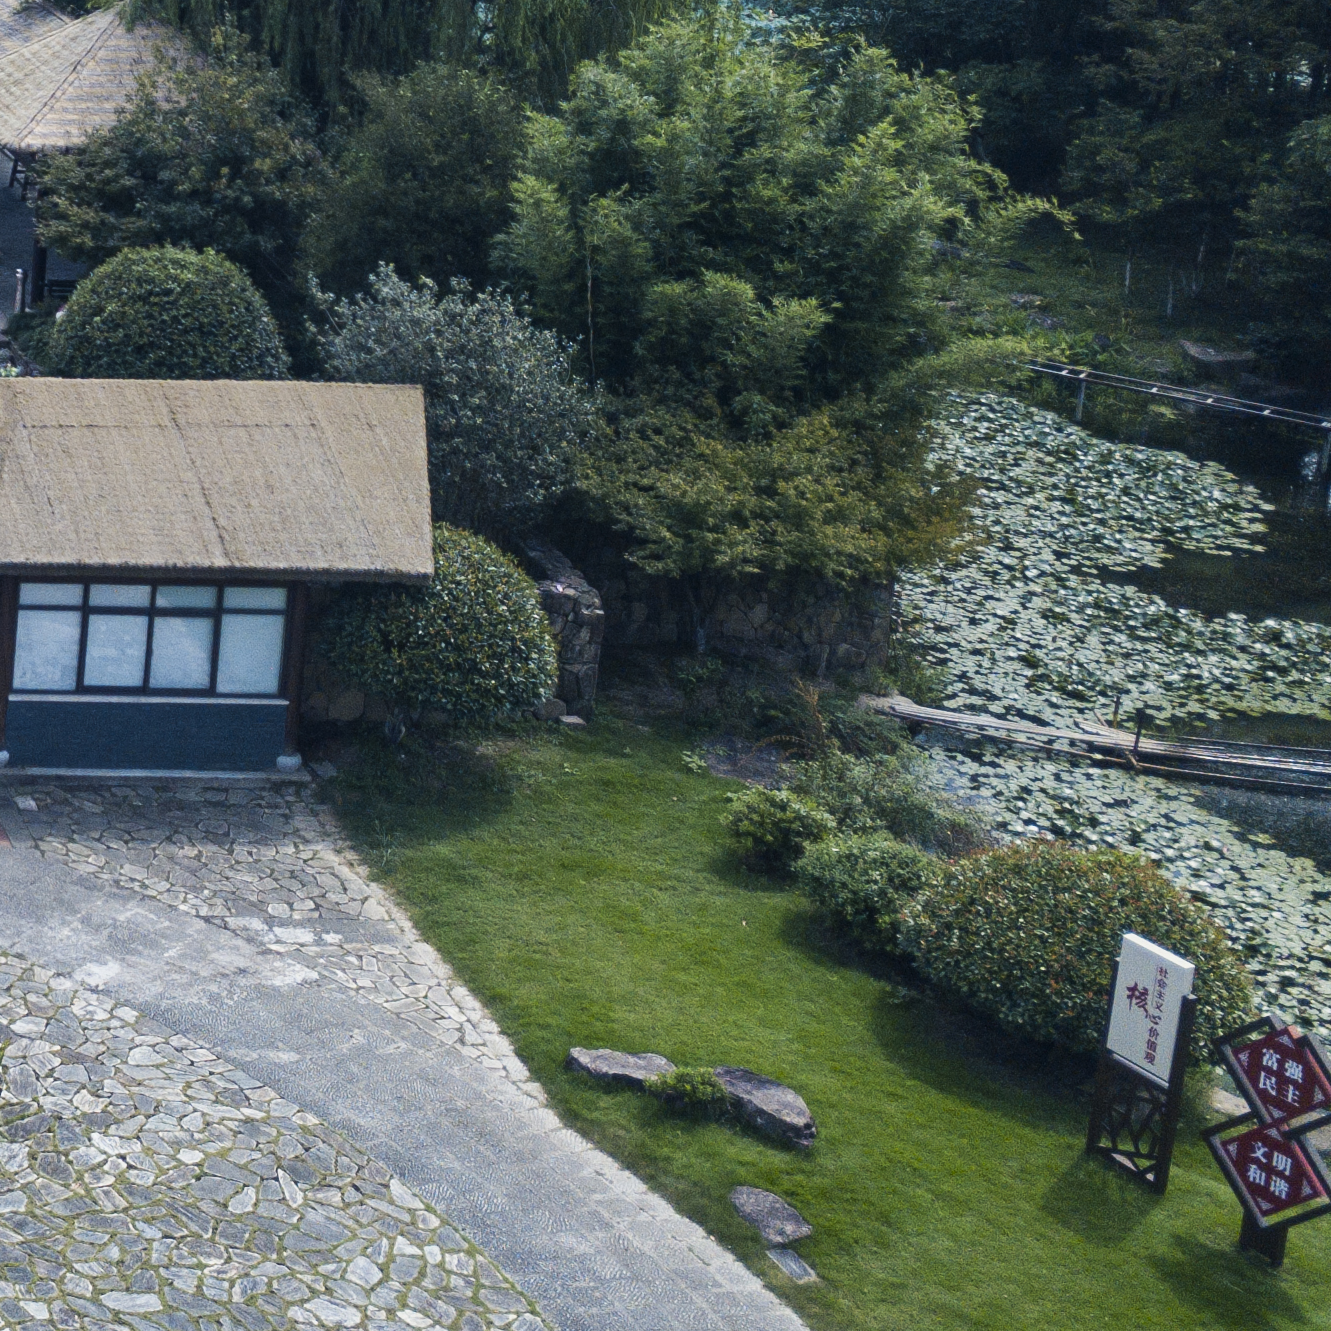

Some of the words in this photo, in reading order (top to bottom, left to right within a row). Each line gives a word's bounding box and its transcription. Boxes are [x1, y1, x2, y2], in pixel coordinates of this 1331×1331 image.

[1155, 966, 1169, 1013] 社会主义
[1262, 1048, 1304, 1084] 富强
[1259, 1071, 1300, 1107] 民主
[1249, 1141, 1293, 1177] 文明
[1246, 1164, 1290, 1200] 和谐
